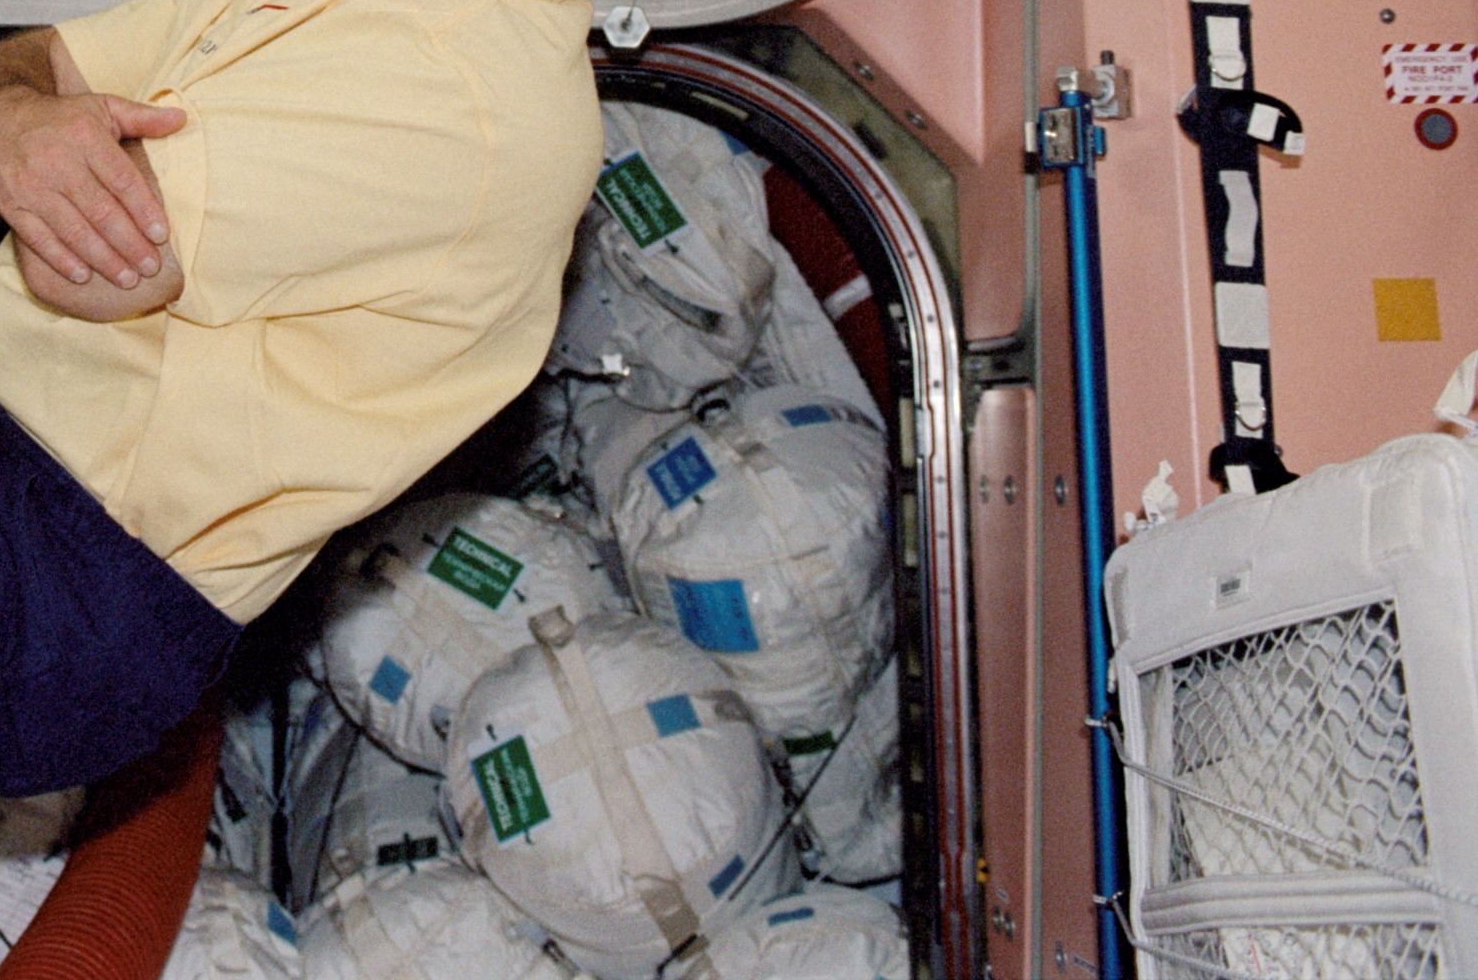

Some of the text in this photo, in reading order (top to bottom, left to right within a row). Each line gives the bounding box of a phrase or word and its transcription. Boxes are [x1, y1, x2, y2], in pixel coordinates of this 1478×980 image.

[1402, 65, 1463, 74] FIRE PORT
[452, 534, 513, 579] TECHNICAL
[483, 758, 513, 832] TECHNICAL
